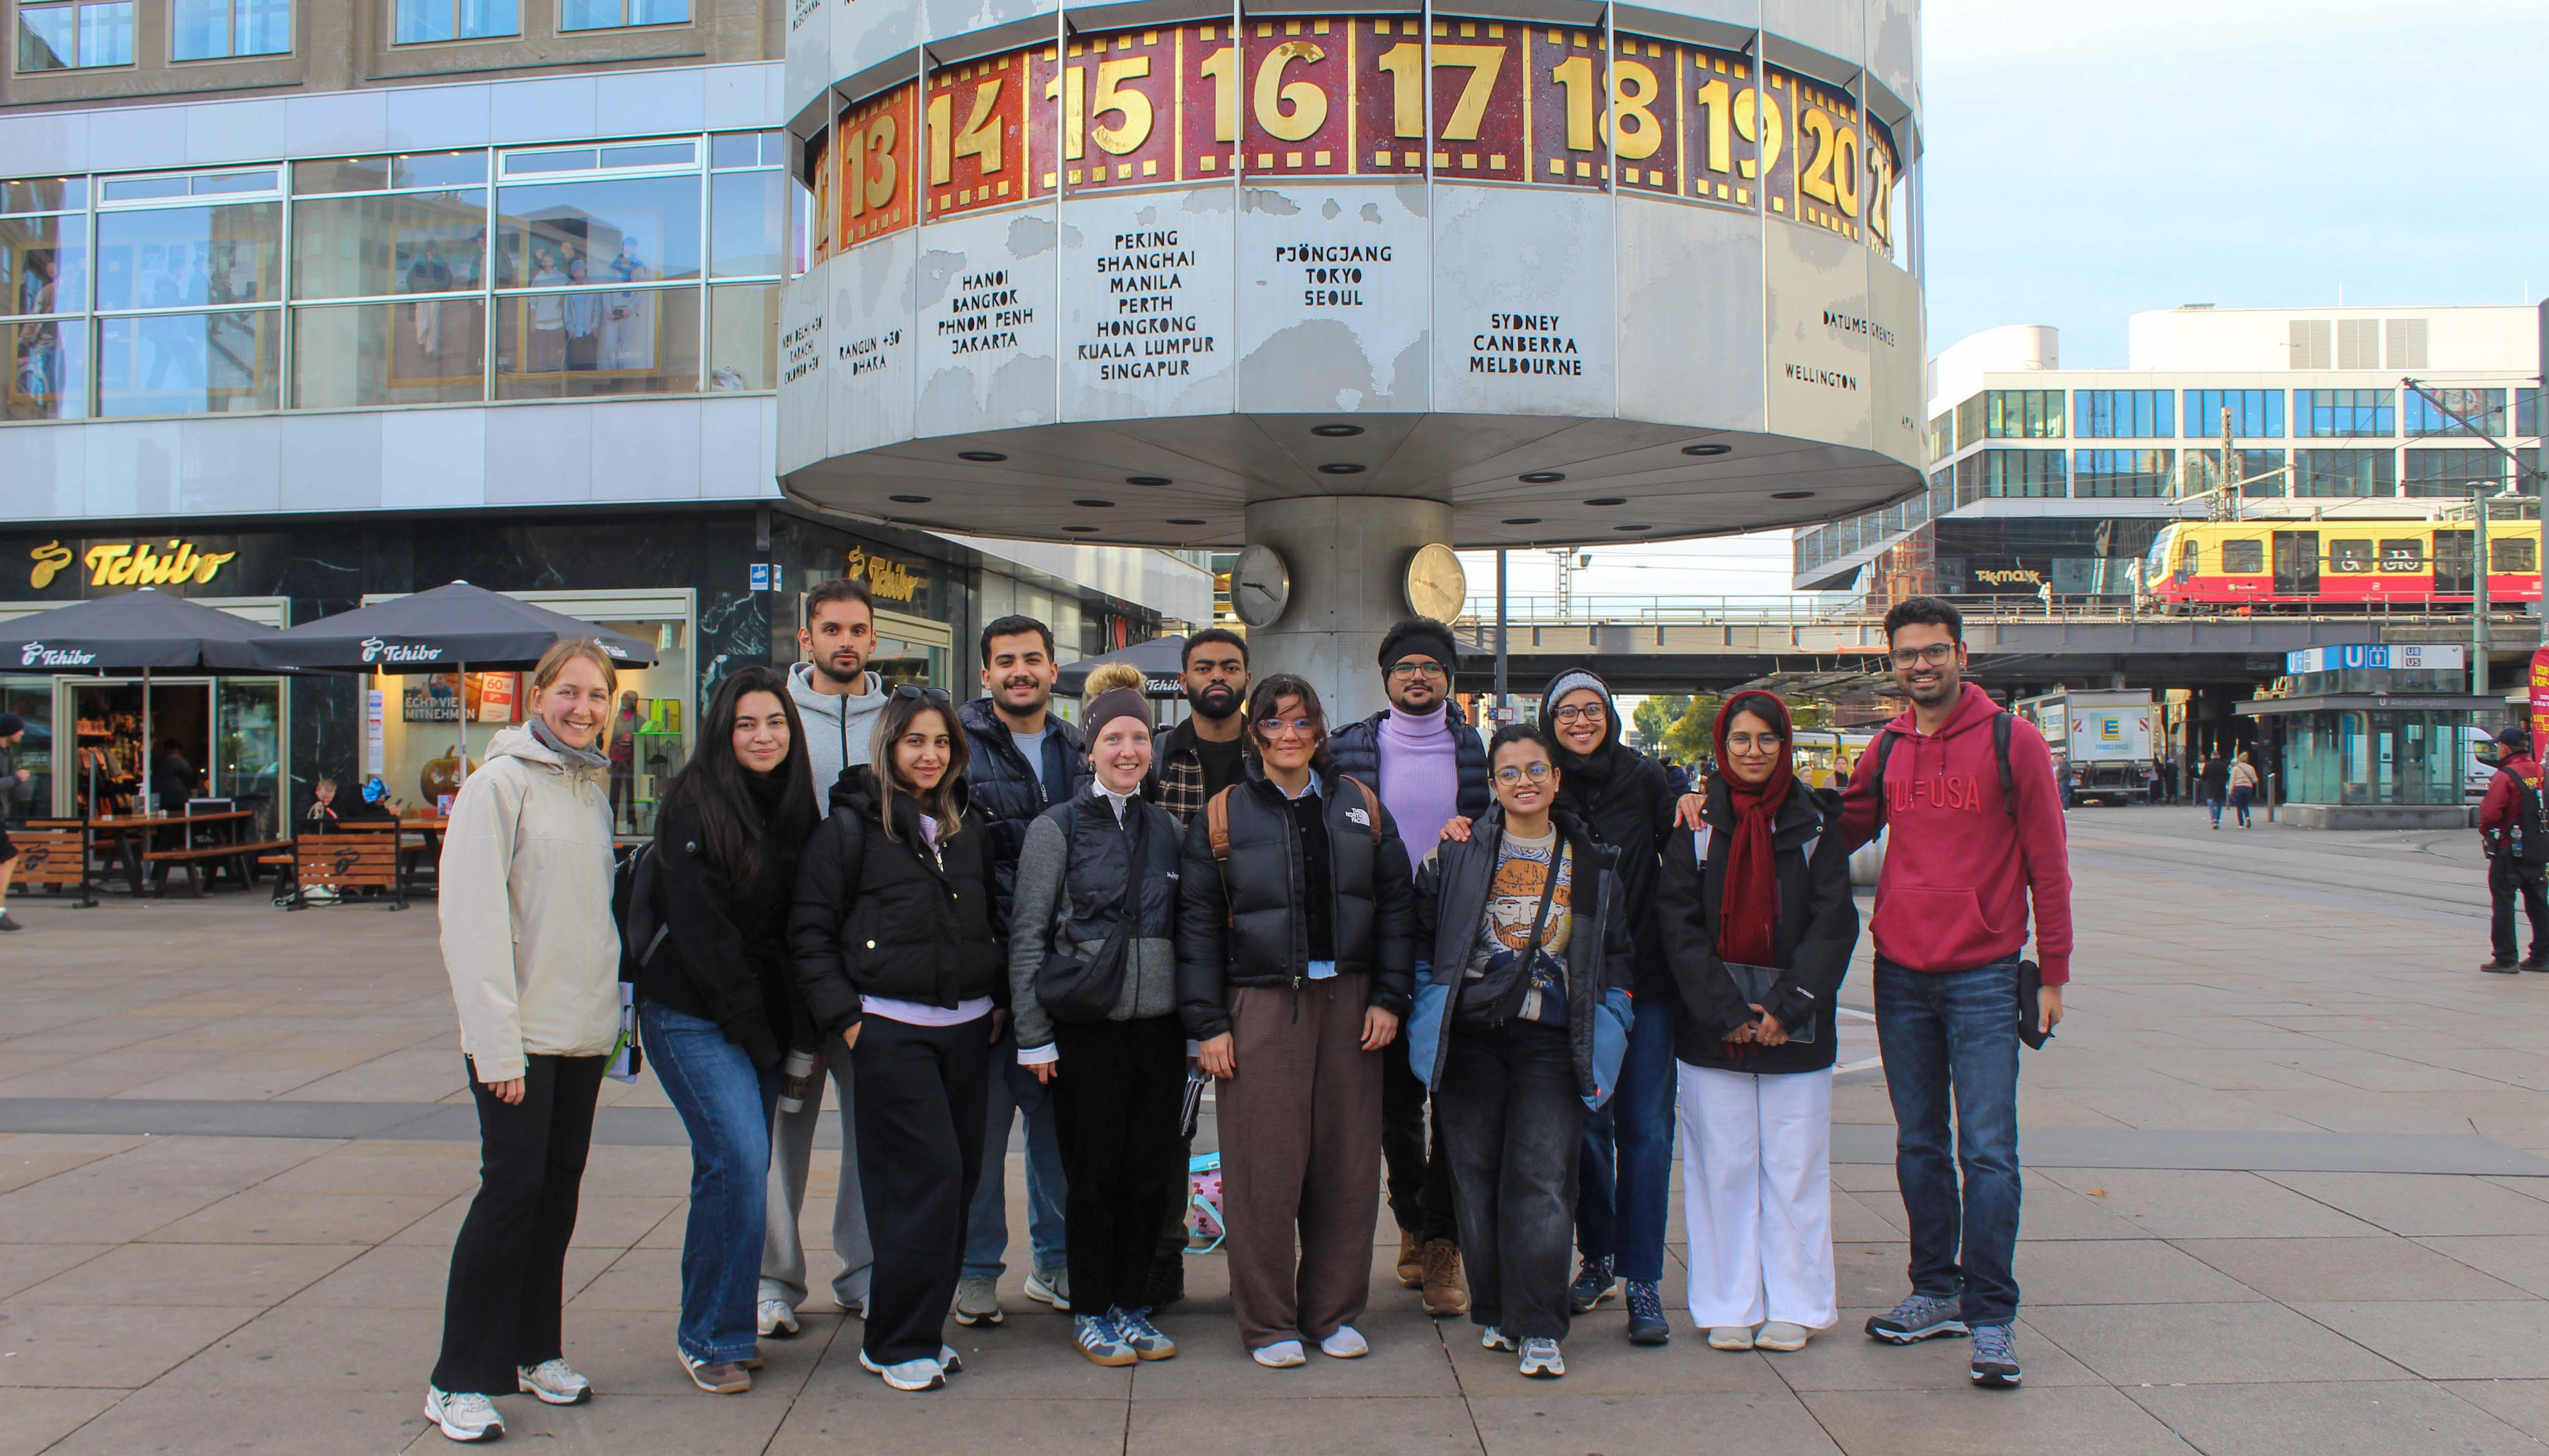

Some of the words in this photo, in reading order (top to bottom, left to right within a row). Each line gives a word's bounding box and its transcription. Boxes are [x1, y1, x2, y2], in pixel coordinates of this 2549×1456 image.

[1201, 40, 1327, 142] 16
[1379, 42, 1507, 141] 17
[1045, 56, 1153, 161] 15
[1553, 56, 1662, 160] 18
[927, 78, 1003, 186] 14
[1698, 79, 1783, 179] 19
[847, 115, 897, 218] 13
[1801, 108, 1858, 218] 20
[1870, 146, 1892, 247] 21
[1115, 231, 1178, 250] PEKING
[1097, 251, 1195, 273] SHANGHAI
[1275, 243, 1392, 262] PJÖNGJANG
[962, 270, 1009, 291] HANOI
[1110, 273, 1183, 293] MANILA
[1305, 268, 1362, 285] TOKYO
[952, 289, 1018, 313] BANGKOK
[1119, 296, 1173, 314] PERTH
[1304, 290, 1363, 306] SEOUL
[795, 322, 810, 343] DELHI
[938, 315, 987, 336] PHNOM
[996, 308, 1034, 327] PENH
[1097, 316, 1196, 337] HONGKONG
[1491, 313, 1560, 333] SYDNEY
[790, 340, 814, 363] KARACHI
[839, 336, 877, 361] RANGUN
[951, 332, 1018, 354] JAKARTA
[1078, 343, 1136, 360] KUALA
[1145, 337, 1215, 356] LUMPUR
[1473, 335, 1578, 354] CANBERRA
[784, 362, 806, 385] COLOMBO
[853, 354, 887, 377] DHAKA
[1100, 360, 1190, 380] SINGAPUR
[1469, 356, 1582, 377] MELBOURNE
[1785, 363, 1857, 391] WELLINGTON
[1901, 415, 1914, 433] APIA
[84, 539, 236, 585] Tchibo
[868, 556, 919, 602] Tchibo
[41, 649, 97, 666] Tchibo
[383, 645, 443, 662] Tchibo
[2345, 646, 2363, 668] U
[2407, 647, 2420, 656] U8
[2406, 658, 2420, 667] U5
[1146, 679, 1183, 691] Tchib
[405, 697, 436, 707] ECHT
[2379, 698, 2386, 706] U
[405, 708, 475, 719] MITNEHMN
